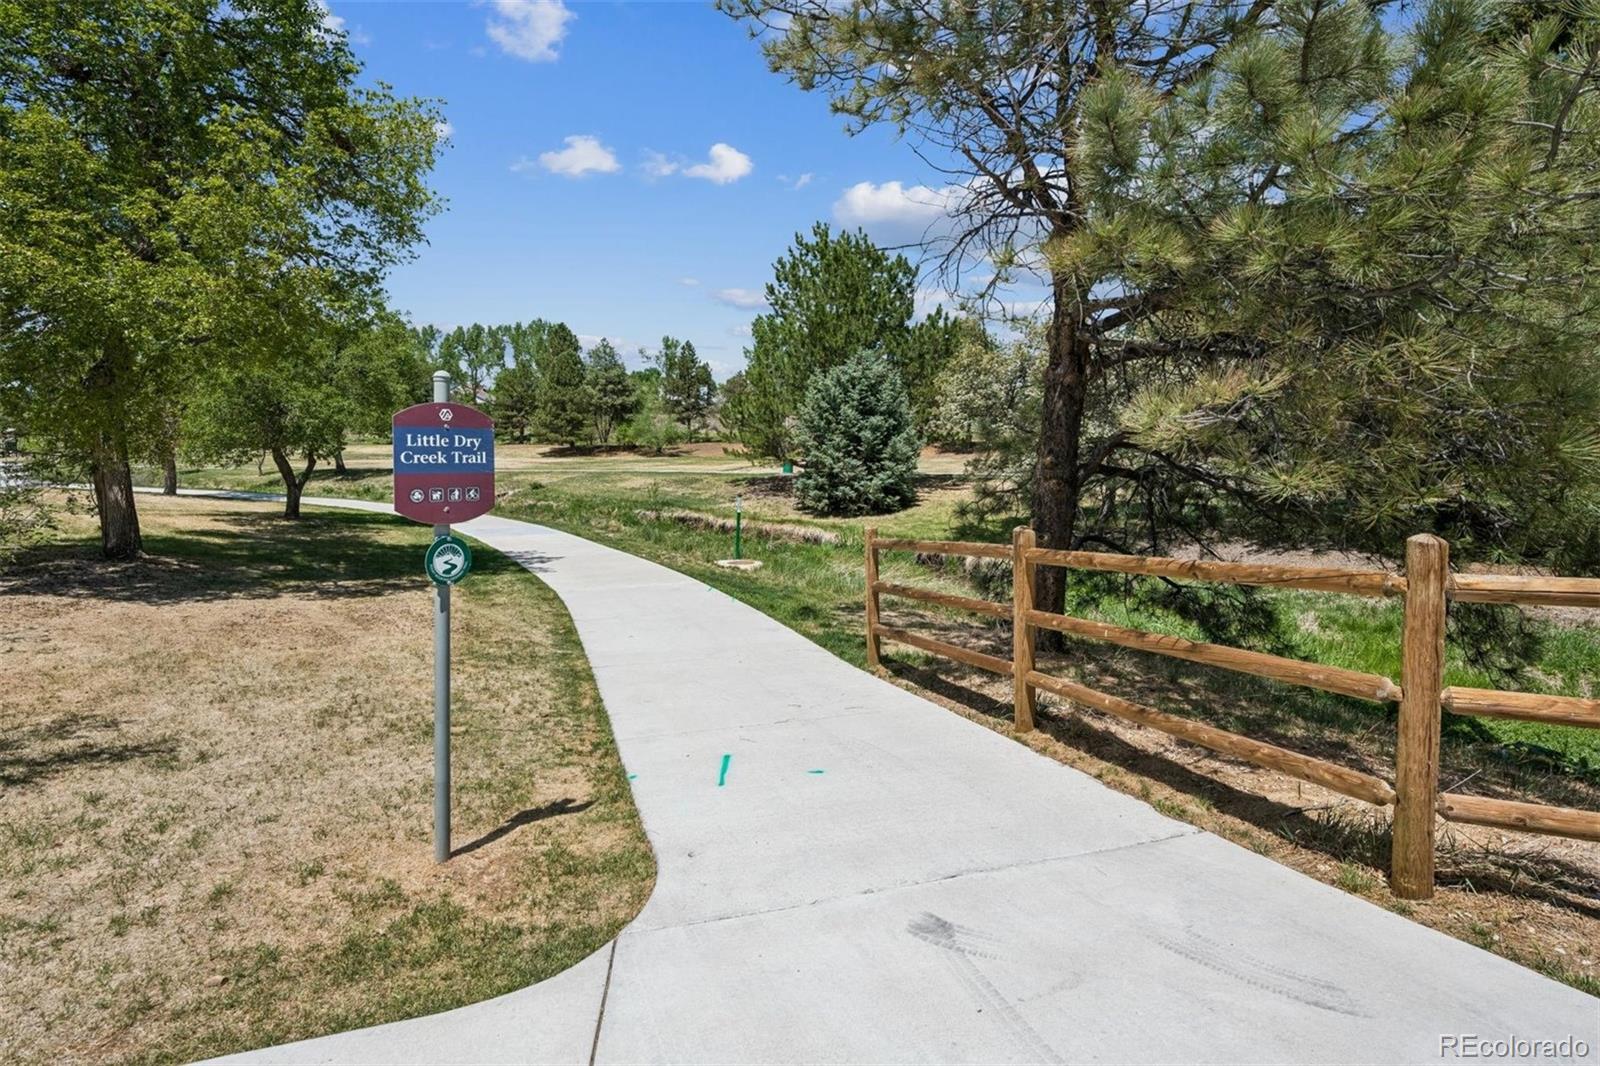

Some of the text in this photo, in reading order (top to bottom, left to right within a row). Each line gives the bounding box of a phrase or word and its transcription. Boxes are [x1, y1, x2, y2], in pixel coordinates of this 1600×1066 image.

[406, 434, 482, 451] Little Dry
[400, 451, 487, 464] Creek Trail
